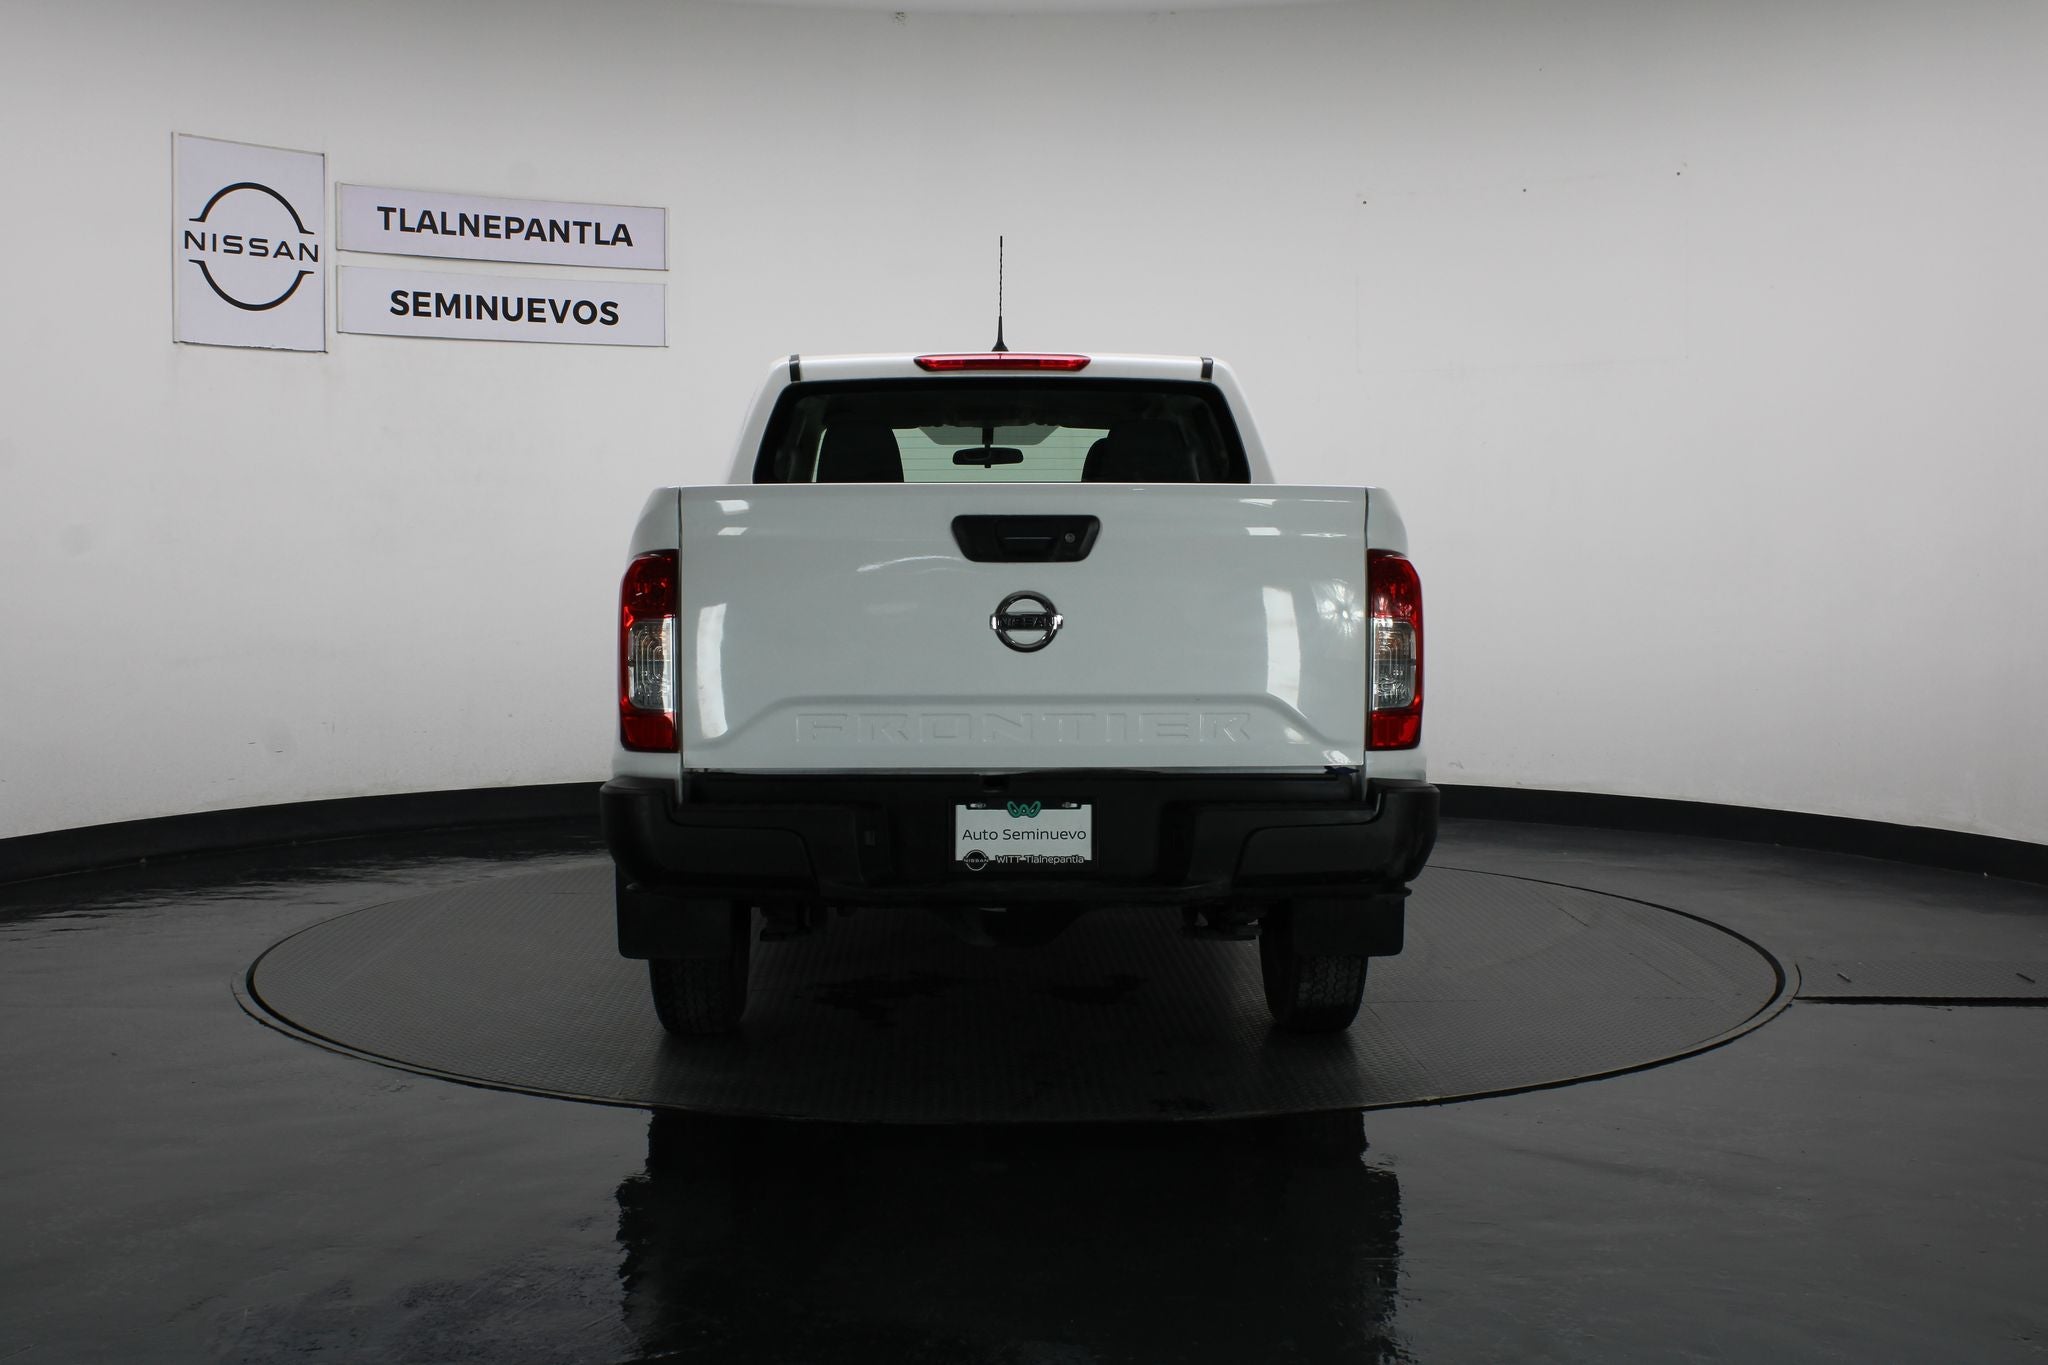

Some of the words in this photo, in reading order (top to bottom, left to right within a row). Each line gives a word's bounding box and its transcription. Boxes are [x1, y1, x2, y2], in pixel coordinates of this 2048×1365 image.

[376, 206, 634, 248] TLALNEPANTLA
[184, 230, 319, 262] NISSAN
[389, 290, 620, 326] SEMINUEVOS
[795, 712, 1252, 744] FRONTIER
[962, 829, 998, 841] Auto
[1002, 828, 1087, 841] Seminuevo
[995, 855, 1020, 864] WITT
[1025, 854, 1085, 865] Tlalnepantla
